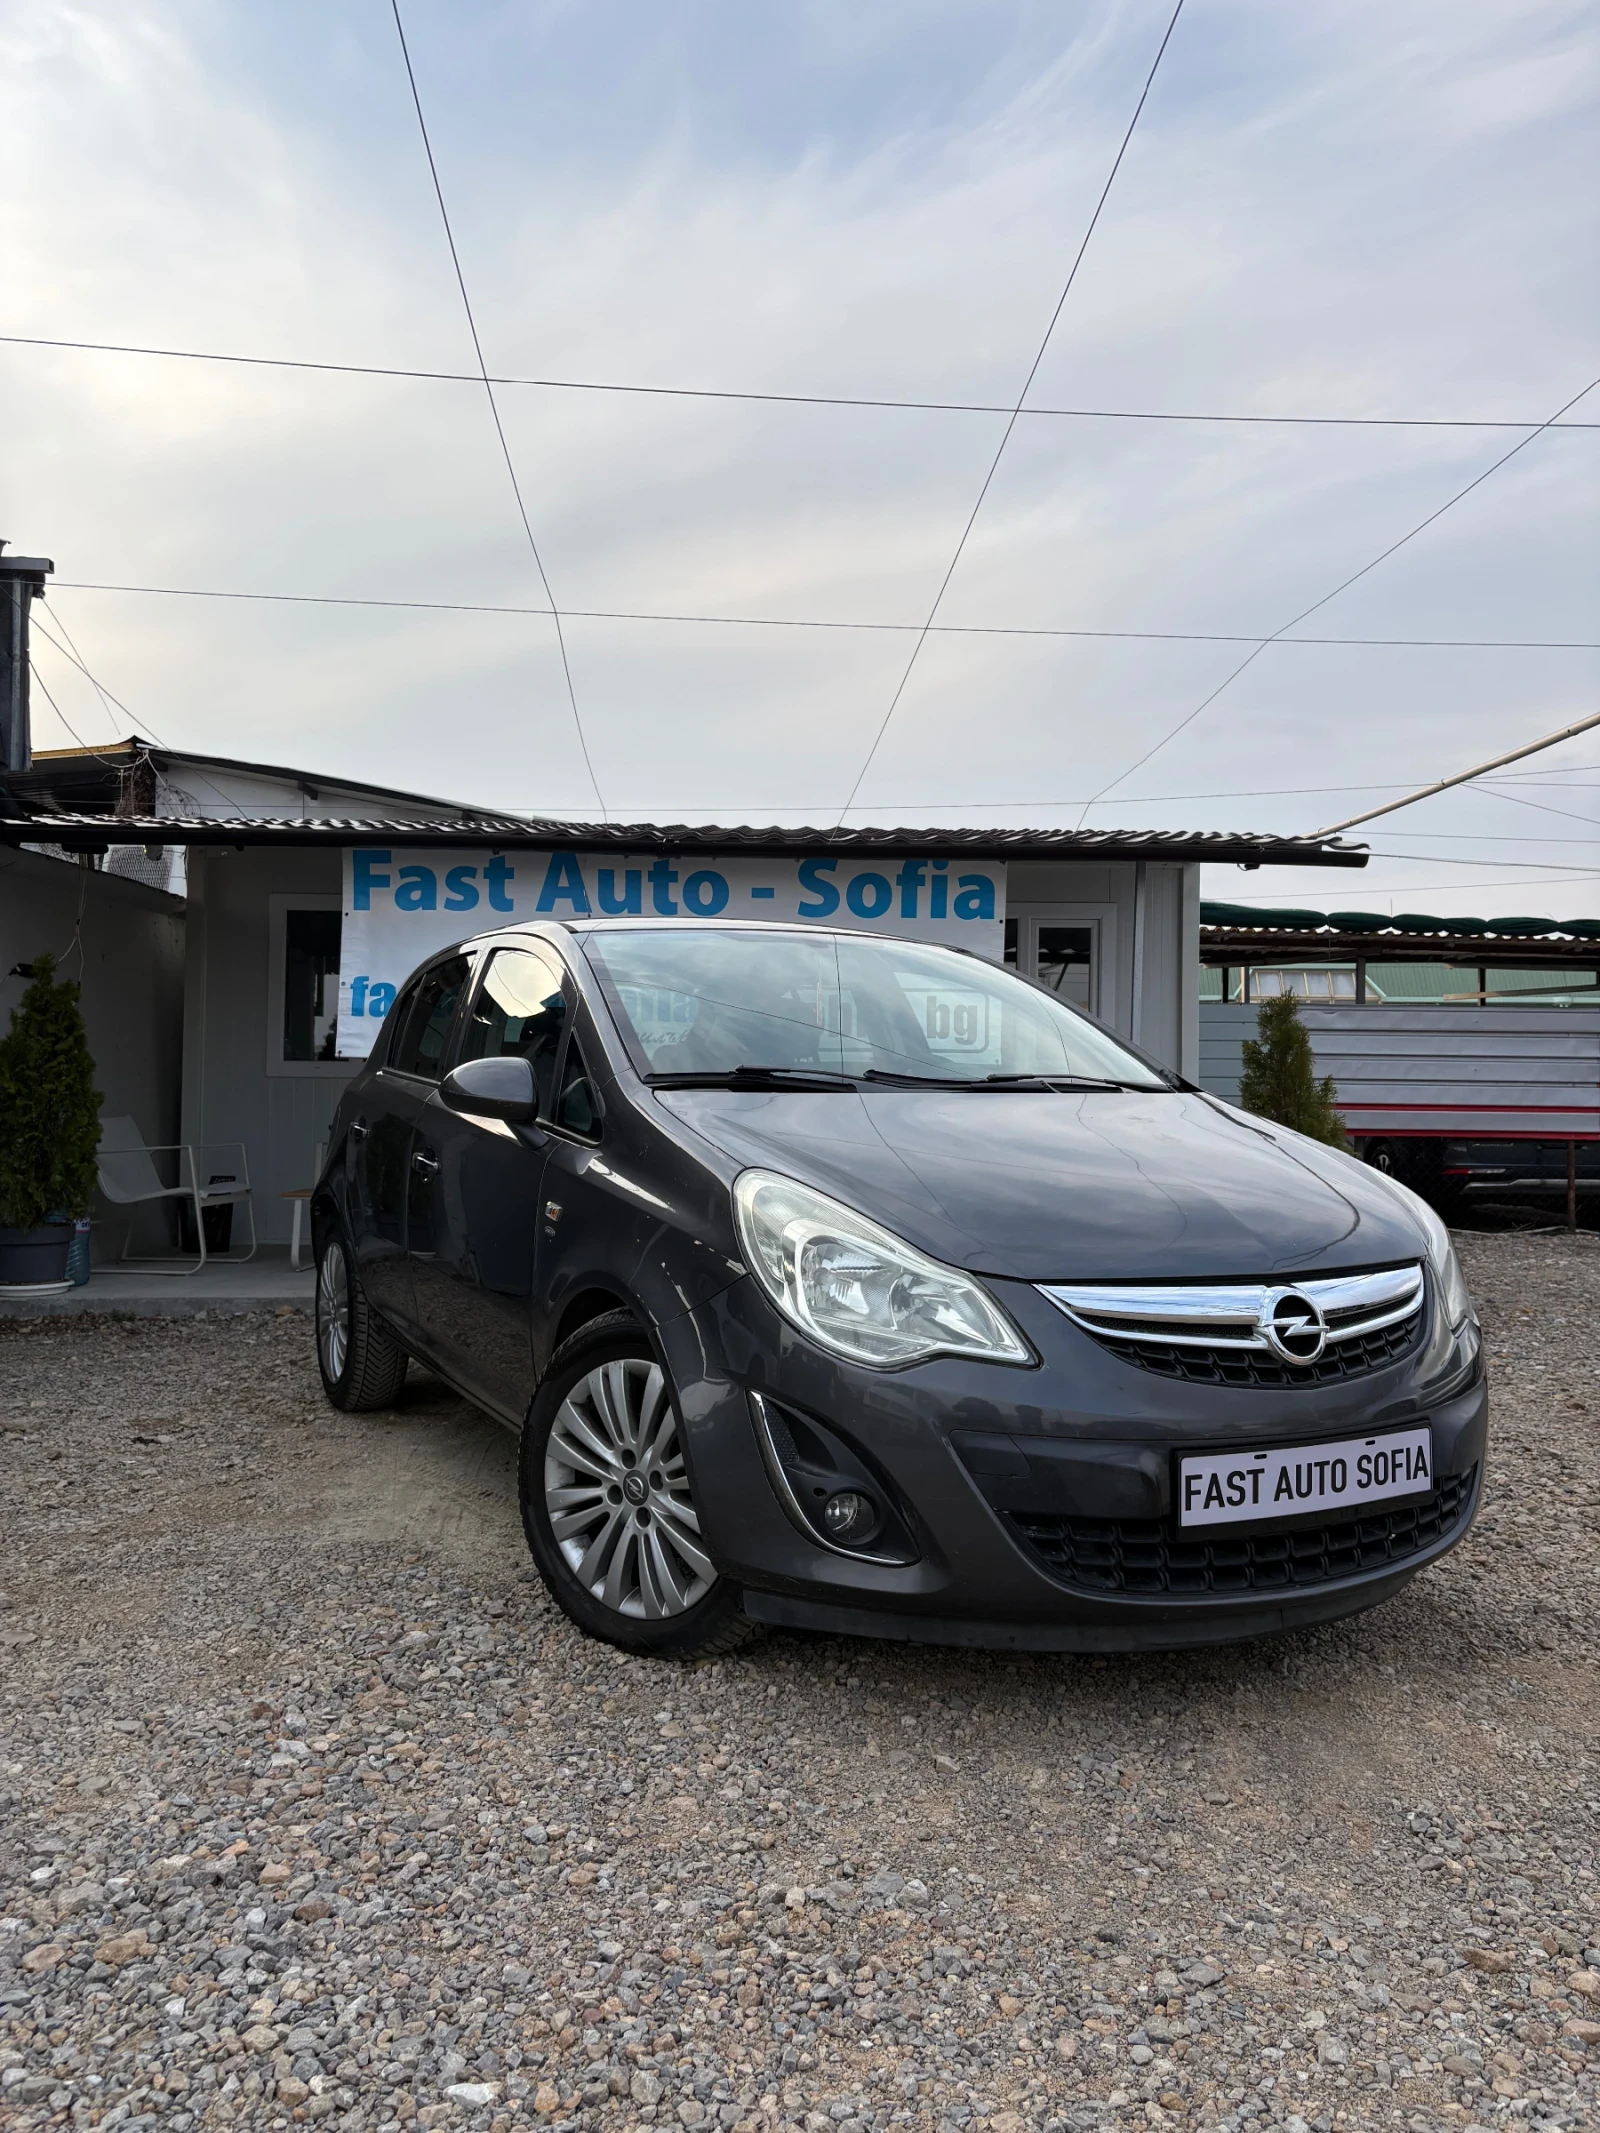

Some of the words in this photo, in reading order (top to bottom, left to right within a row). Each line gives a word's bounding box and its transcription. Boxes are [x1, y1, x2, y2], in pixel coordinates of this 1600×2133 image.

[352, 849, 515, 914] Fast
[536, 852, 730, 917] Auto
[751, 887, 775, 899] -
[797, 860, 996, 920] Sofia
[1185, 1468, 1265, 1512] FAST
[1273, 1458, 1347, 1502] AUTO
[1356, 1445, 1429, 1489] SOFIA
